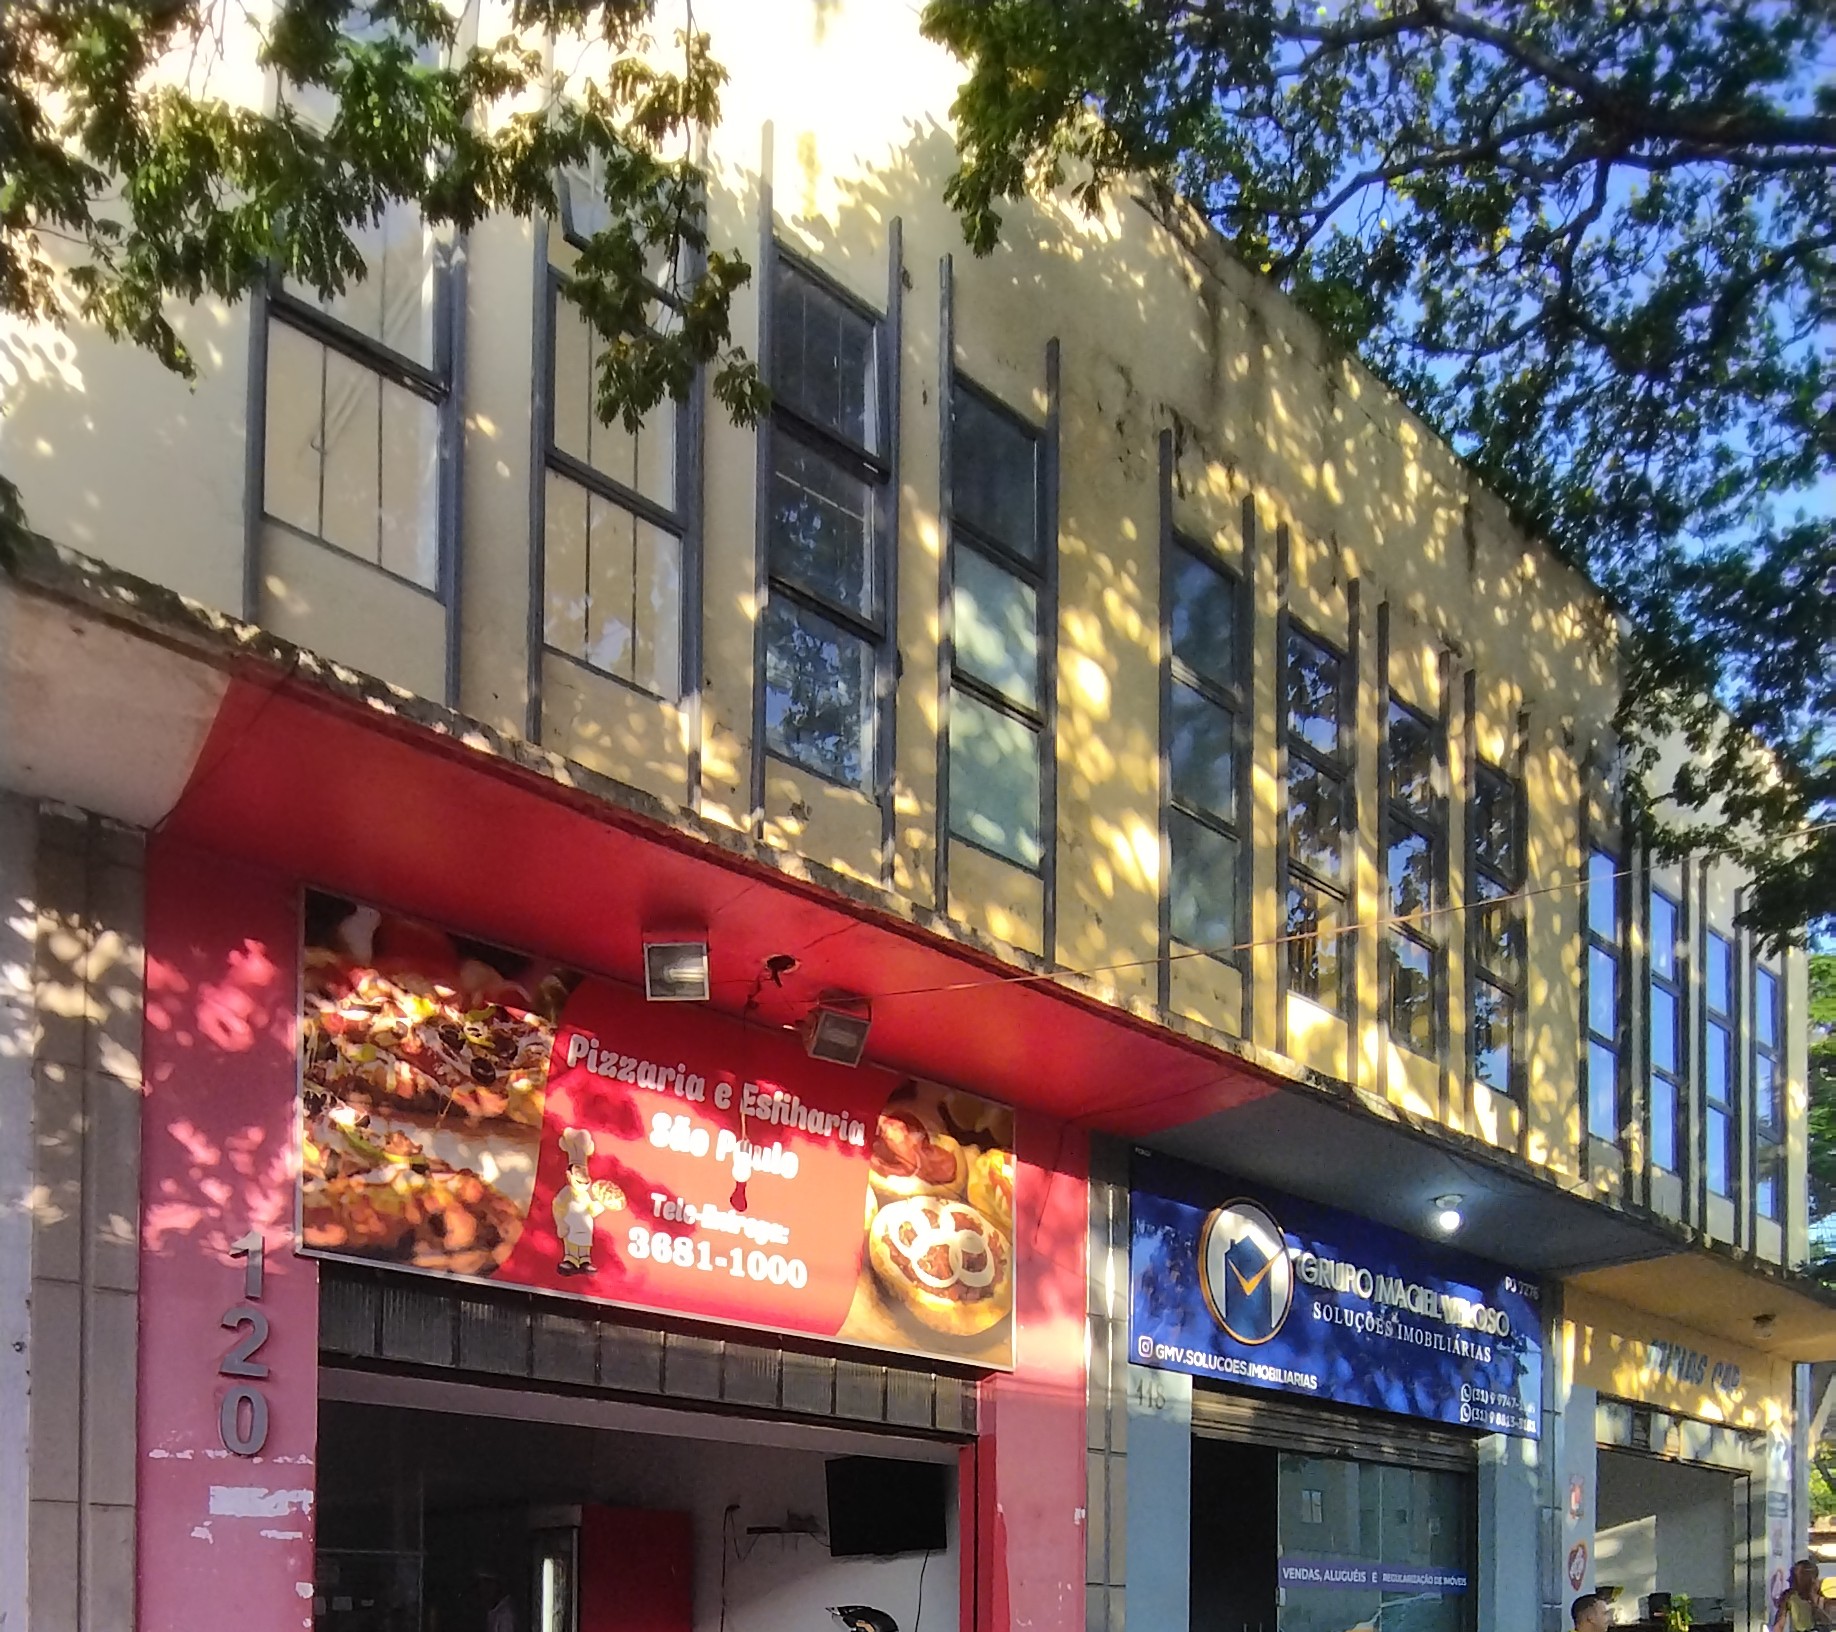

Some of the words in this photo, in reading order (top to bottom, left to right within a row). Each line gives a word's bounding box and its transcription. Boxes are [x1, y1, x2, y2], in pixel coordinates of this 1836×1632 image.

[567, 1033, 705, 1103] Pizzaria
[714, 1082, 733, 1110] e
[739, 1082, 866, 1147] Esfiharia
[649, 1112, 710, 1157] São
[715, 1128, 799, 1180] Pulo
[627, 1225, 809, 1290] 3681-1000
[1299, 1251, 1375, 1299] GRUPO
[1373, 1274, 1443, 1319] MACIEL
[1440, 1293, 1511, 1338] VELOSO
[218, 1231, 270, 1457] 120
[1312, 1301, 1394, 1338] SOLUÇÕES
[1396, 1323, 1492, 1364] IMOBILIÁRIAS
[1135, 1377, 1167, 1410] 118
[1155, 1343, 1318, 1391] GMV.SOLUCOES.IMOBILIARIAS
[1282, 1567, 1323, 1582] VENDAS,
[1324, 1569, 1367, 1583] ALUGUÉIS
[1371, 1572, 1378, 1583] E
